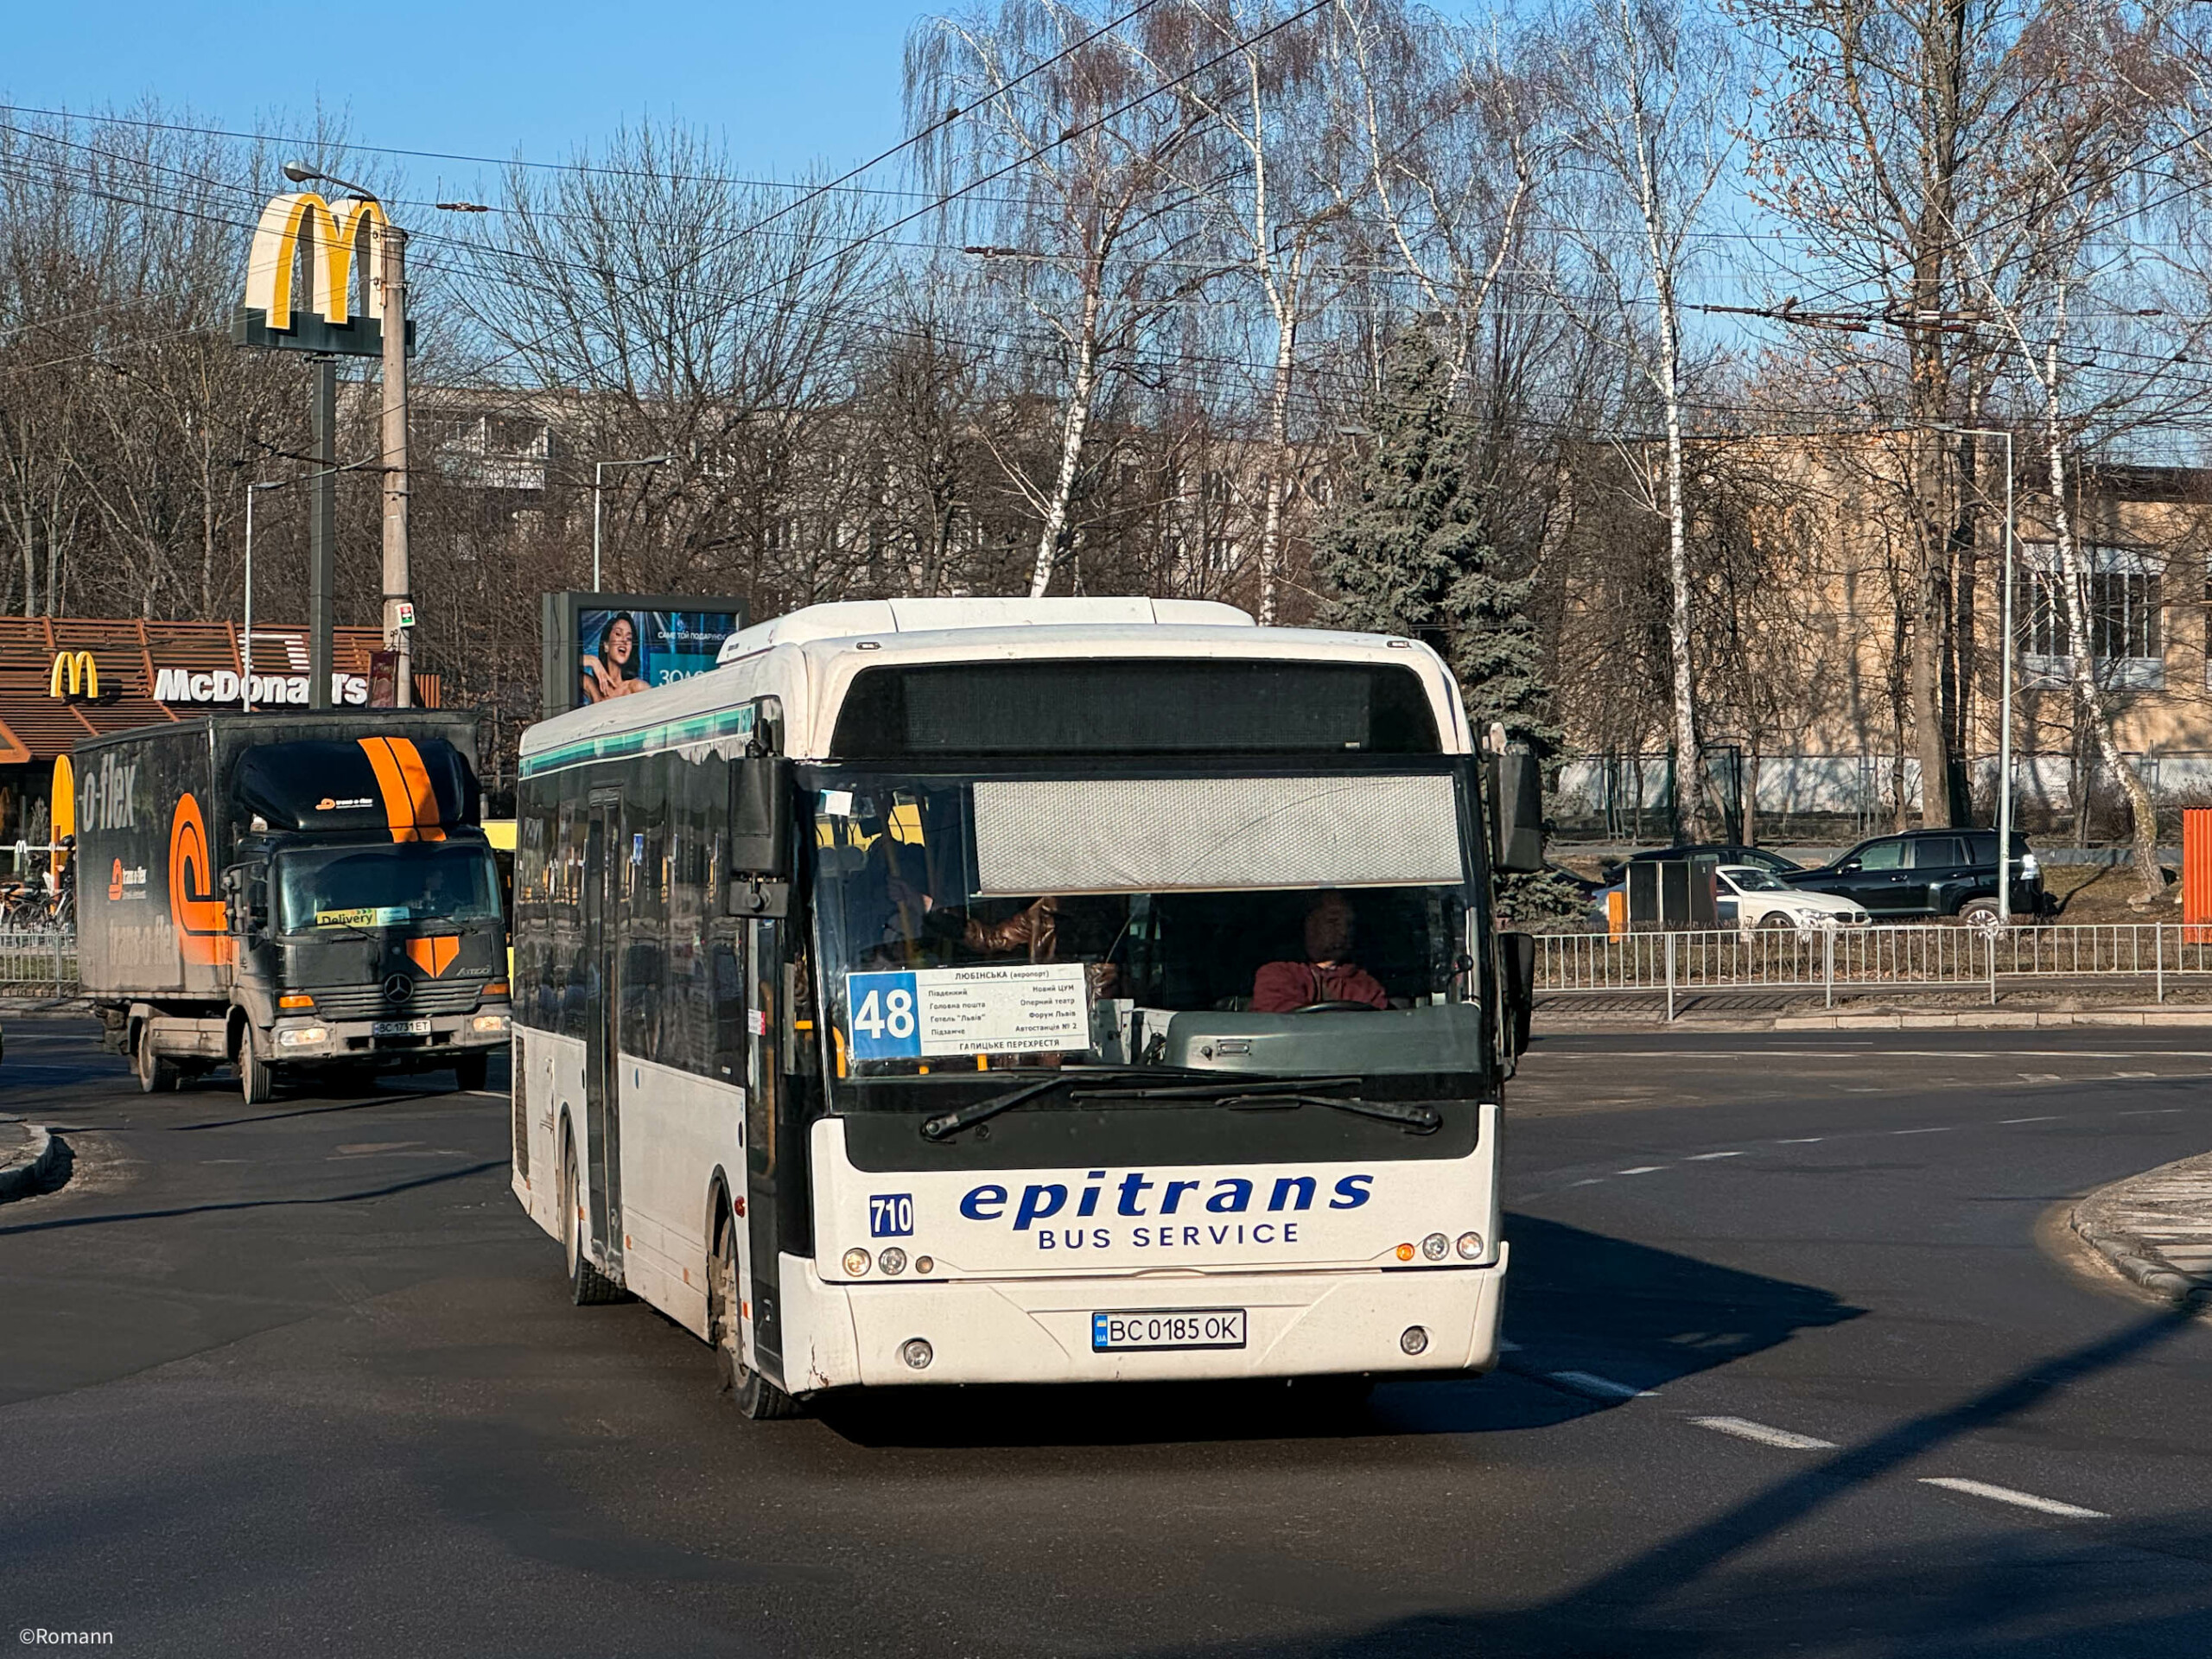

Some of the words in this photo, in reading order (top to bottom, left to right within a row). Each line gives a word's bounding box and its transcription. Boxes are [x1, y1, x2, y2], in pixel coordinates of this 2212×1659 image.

[153, 669, 368, 704] McDona's
[321, 914, 373, 925] Delivery
[955, 971, 1007, 980] ЛЮБІНСЬКА
[1010, 969, 1050, 980] (аеропорт)
[1033, 984, 1056, 993] Новий
[1020, 998, 1052, 1007] Оперний
[1055, 997, 1075, 1006] театр
[855, 988, 915, 1039] 48
[1055, 1009, 1076, 1018] Львів
[416, 1020, 429, 1031] ET
[1015, 1023, 1060, 1033] Автостанція
[1007, 1039, 1060, 1049] ПЕРЕХРЕСТЯ
[960, 1171, 1374, 1230] epitrans
[871, 1198, 912, 1233] 710
[1039, 1228, 1110, 1249] BUS
[1132, 1223, 1298, 1247] SERVICE
[1110, 1319, 1142, 1342] BC
[1148, 1318, 1199, 1340] 0185
[1205, 1316, 1237, 1339] OK
